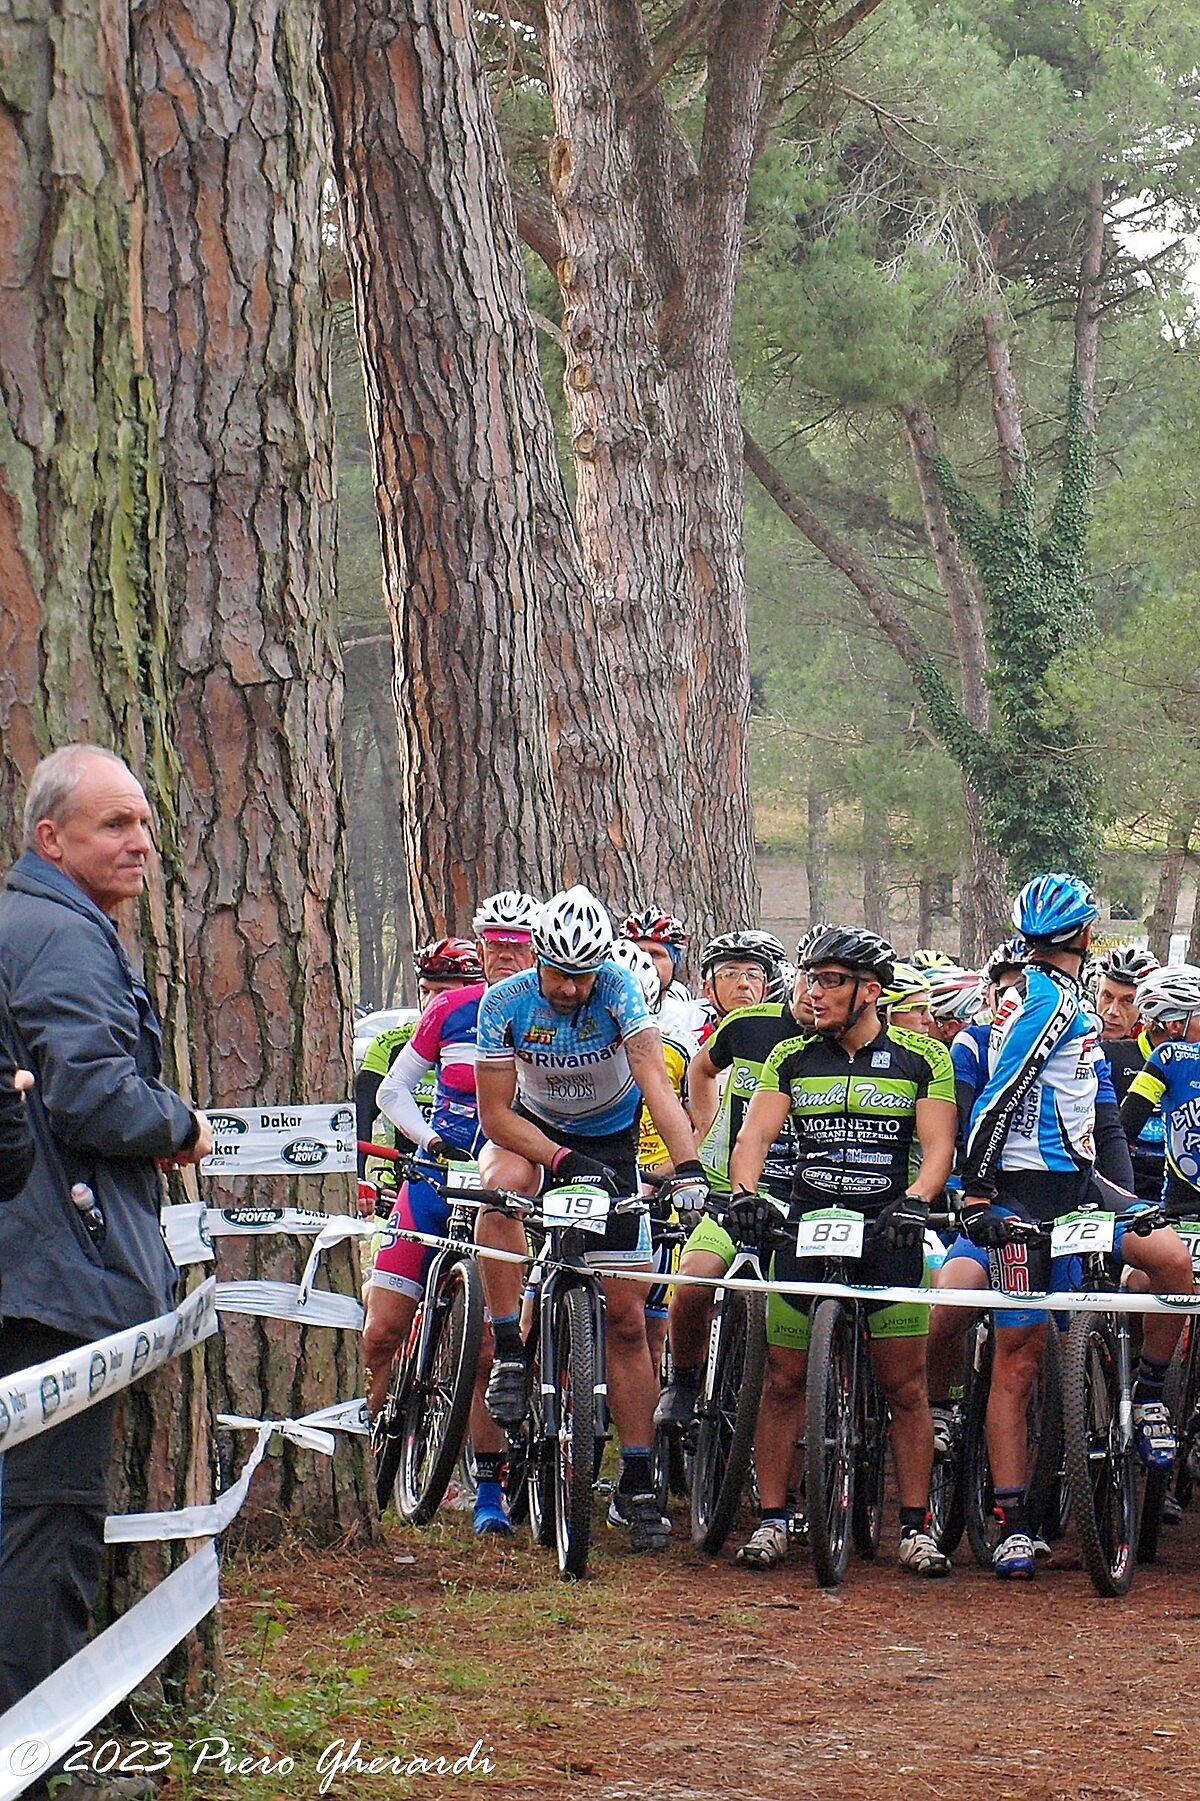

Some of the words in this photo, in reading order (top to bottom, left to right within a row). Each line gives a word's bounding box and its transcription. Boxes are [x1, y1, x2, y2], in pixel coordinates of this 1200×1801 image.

[535, 1042, 619, 1069] Rivamar
[551, 1083, 594, 1099] FOODS
[791, 1083, 847, 1108] Sambi
[854, 1083, 914, 1109] Team
[260, 1113, 303, 1129] Dakar
[801, 1117, 900, 1133] MOLINETTO
[295, 1151, 323, 1162] ROVER
[564, 1197, 593, 1215] 19
[236, 1210, 277, 1223] ROVER
[812, 1223, 853, 1242] 83
[1065, 1222, 1100, 1242] 72
